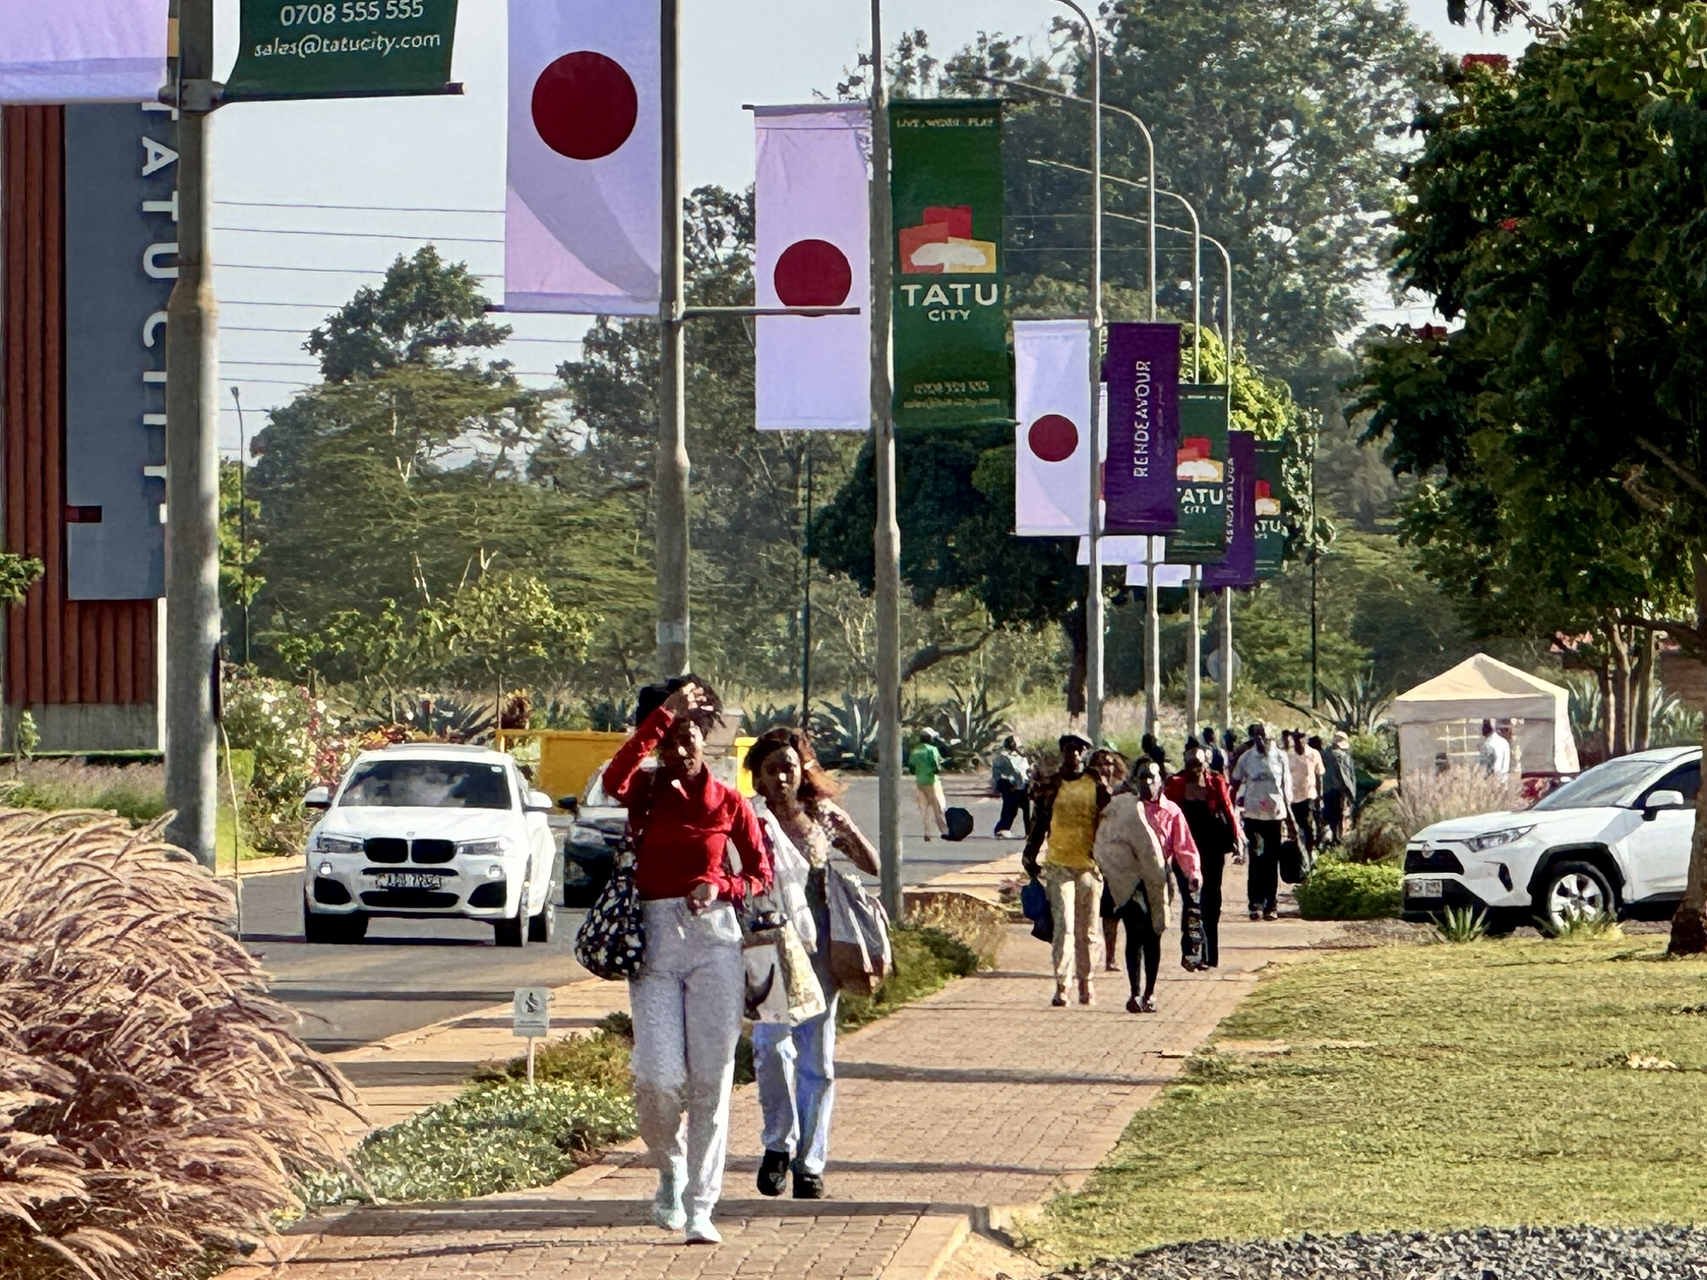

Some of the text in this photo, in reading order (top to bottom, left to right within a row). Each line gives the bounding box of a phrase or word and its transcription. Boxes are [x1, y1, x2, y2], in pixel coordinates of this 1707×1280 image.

[279, 3, 337, 27] 0708
[341, 0, 380, 23] 555
[253, 30, 441, 59] sales@tatucity.com
[899, 282, 999, 308] TATU
[927, 308, 972, 323] CITY
[1176, 487, 1224, 505] ATU
